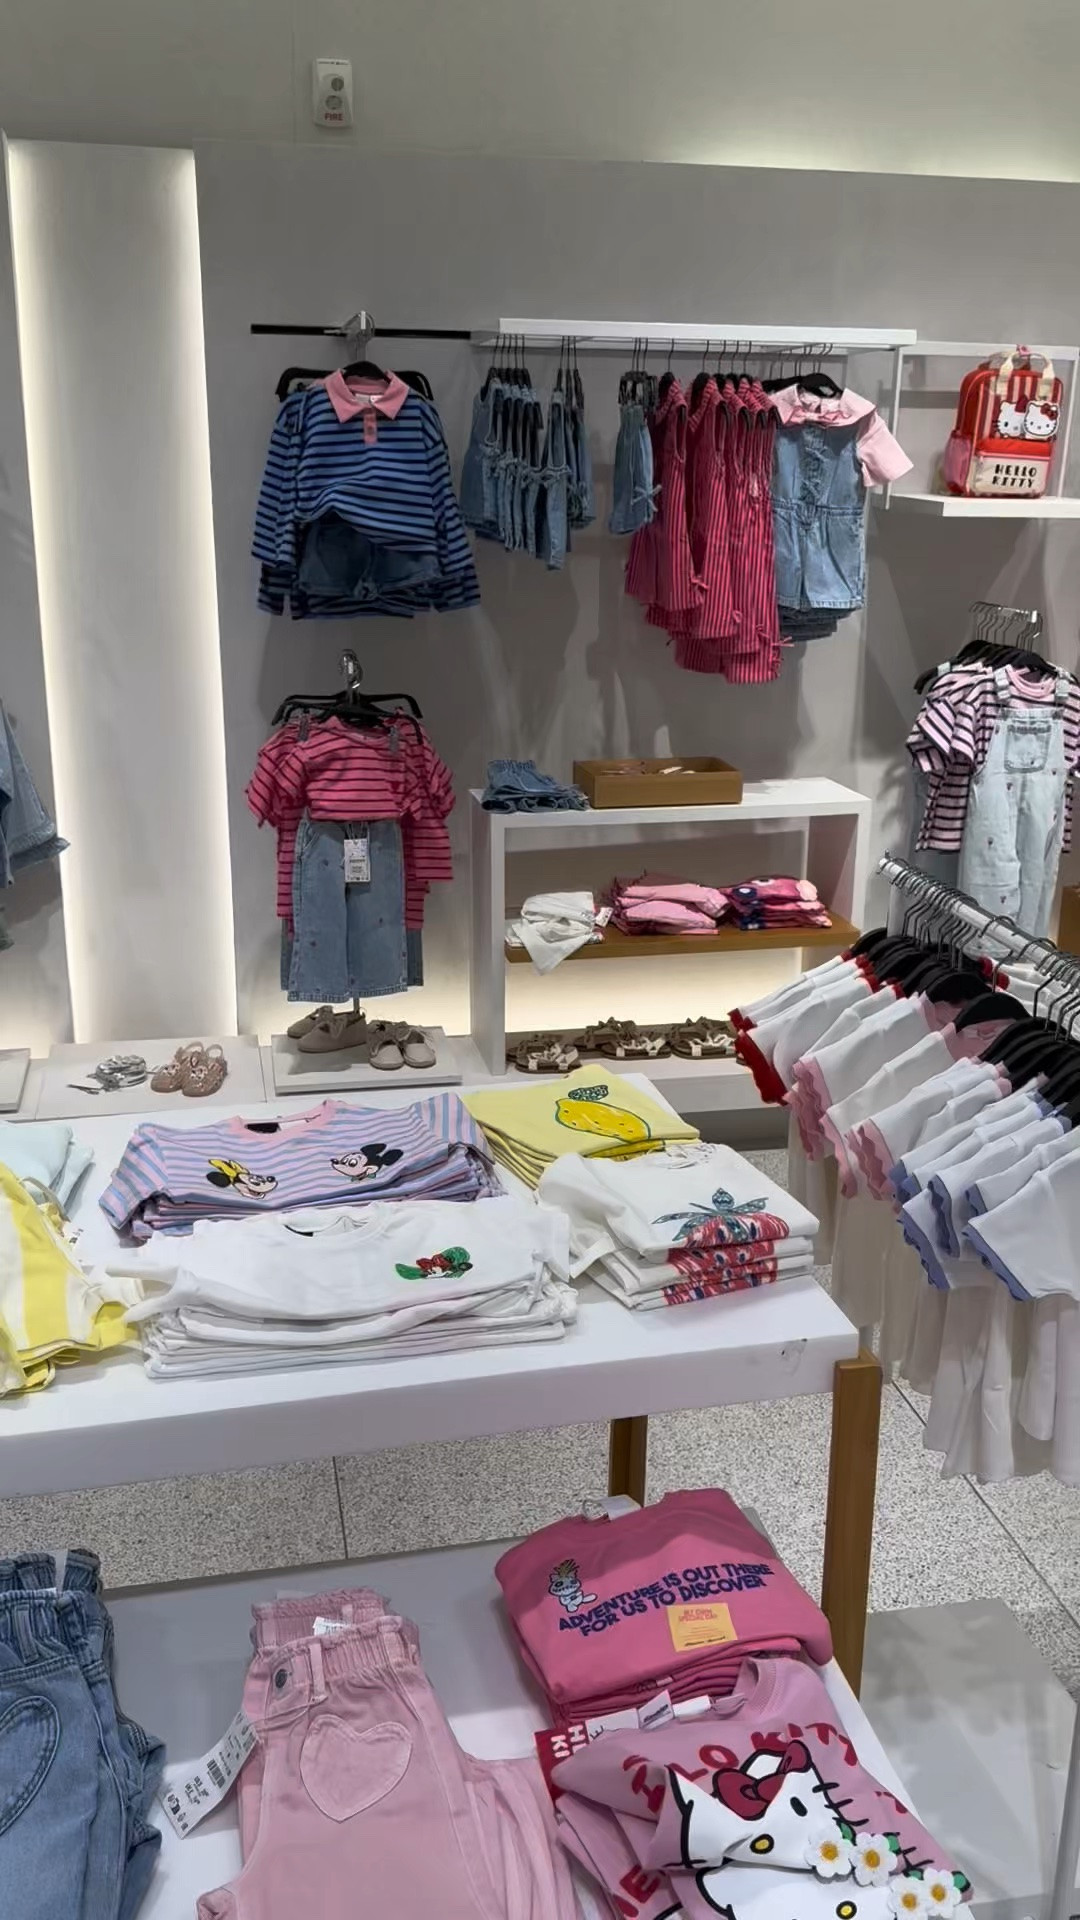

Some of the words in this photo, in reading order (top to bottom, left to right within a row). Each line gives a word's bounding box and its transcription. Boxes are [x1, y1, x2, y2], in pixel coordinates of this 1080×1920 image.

[324, 112, 344, 121] FIRE
[995, 464, 1037, 477] HELLO
[992, 475, 1035, 488] KITTY
[559, 1581, 665, 1631] ADVENTURE
[662, 1572, 682, 1588] IS
[682, 1565, 720, 1583] OUT
[720, 1563, 775, 1577] THERE
[580, 1612, 621, 1637] FOR
[620, 1599, 648, 1617] US
[647, 1590, 676, 1609] TO
[678, 1574, 768, 1602] DISCOVER
